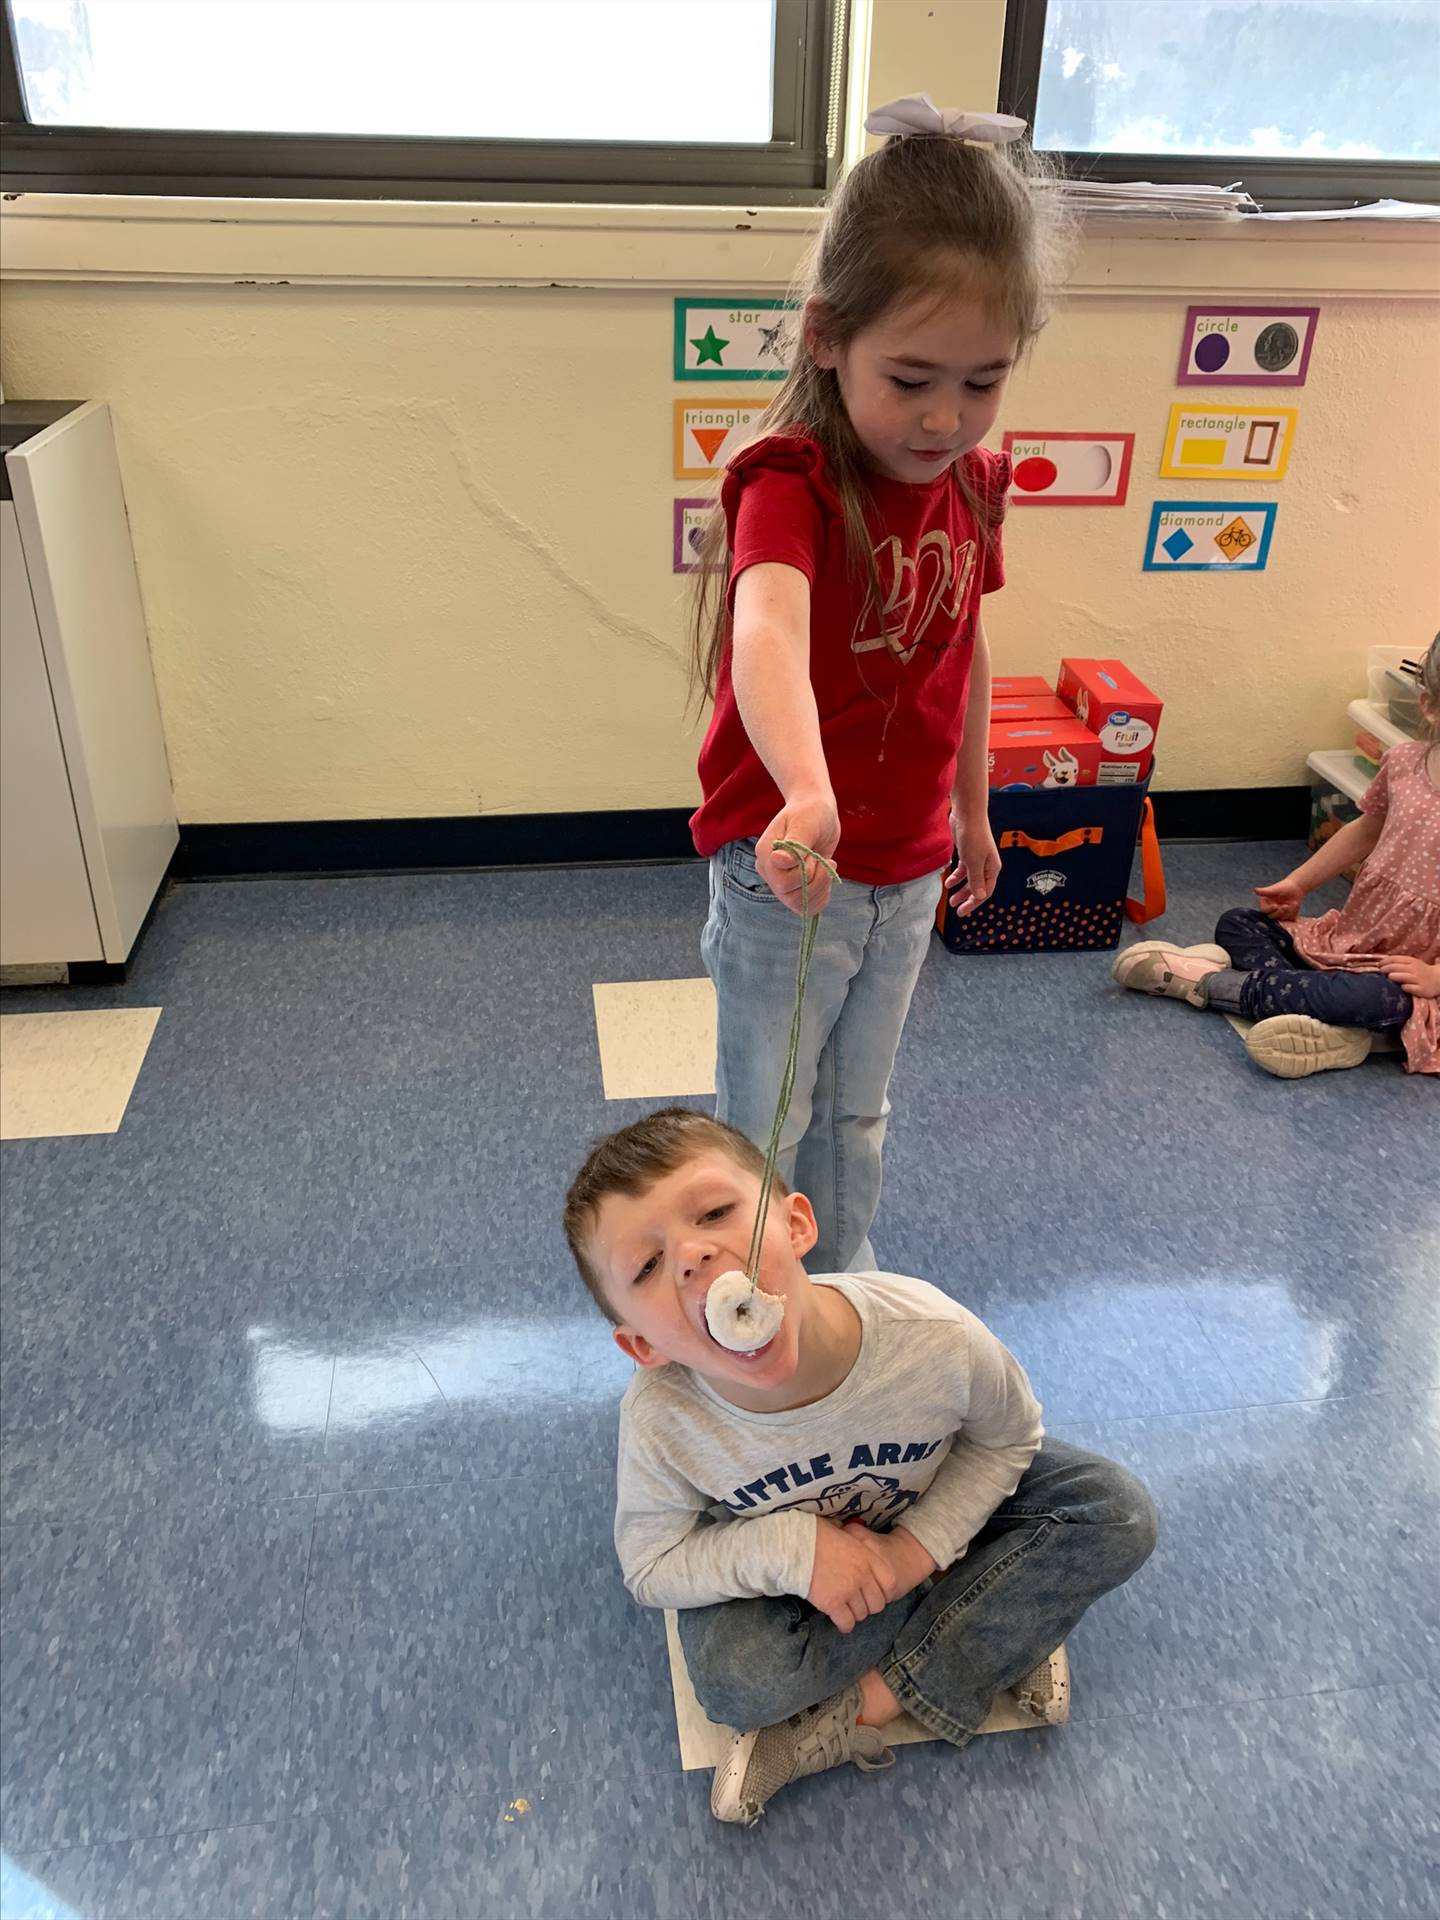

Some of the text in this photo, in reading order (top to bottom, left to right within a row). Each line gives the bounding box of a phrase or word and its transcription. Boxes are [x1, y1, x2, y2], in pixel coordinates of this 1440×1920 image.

[729, 311, 761, 324] star
[1197, 318, 1239, 333] circle
[685, 411, 751, 428] triangle
[1180, 415, 1247, 433] rectangle
[1013, 442, 1047, 456] oval
[1160, 513, 1225, 527] diamond
[1114, 731, 1140, 742] Fruit
[719, 1453, 834, 1511] LITTLE
